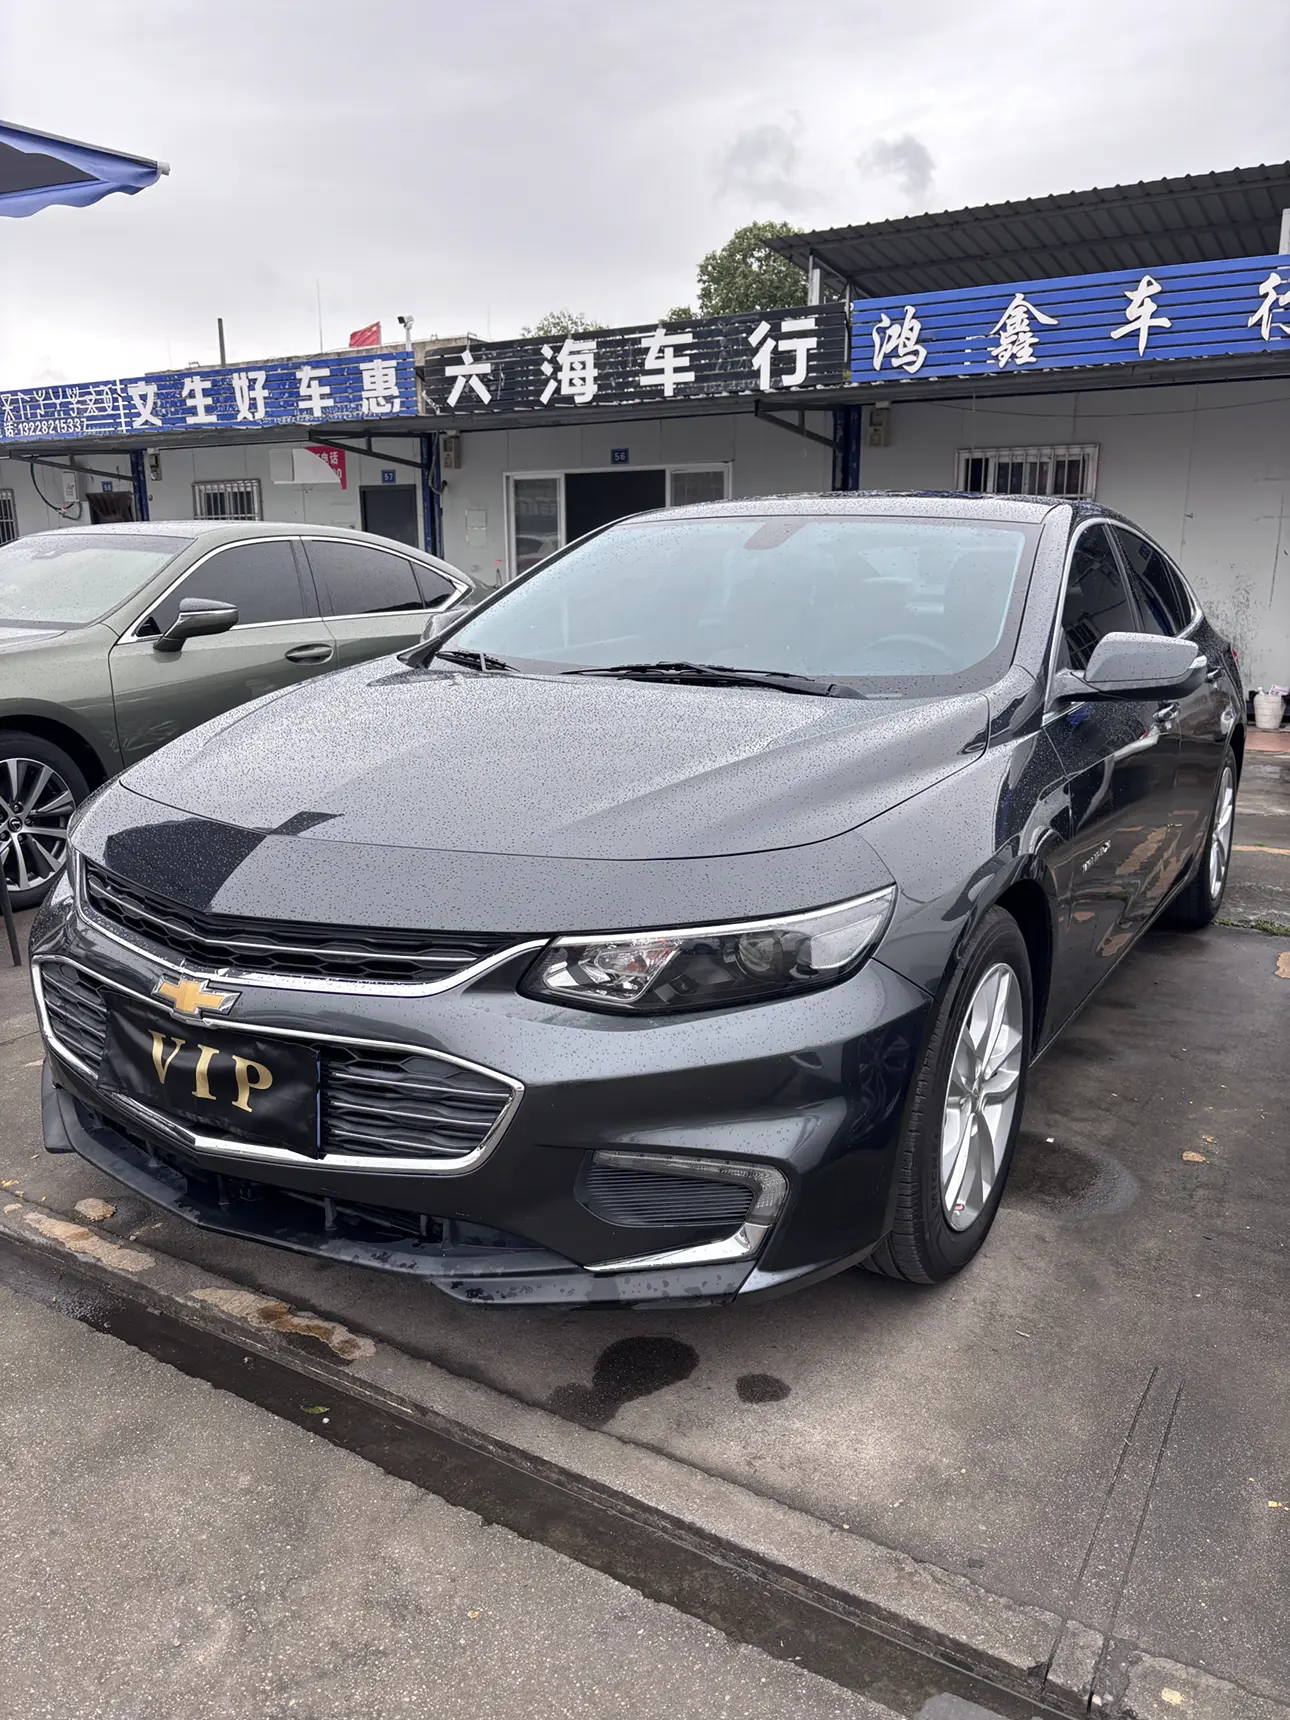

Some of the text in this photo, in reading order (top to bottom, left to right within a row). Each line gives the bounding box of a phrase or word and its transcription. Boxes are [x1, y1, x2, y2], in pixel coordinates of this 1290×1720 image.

[445, 318, 817, 408] 六海车行
[128, 359, 400, 427] 文生好车惠
[0, 418, 86, 438] 话:13228215337
[384, 472, 393, 481] 57
[614, 451, 626, 461] 56
[148, 1029, 273, 1112] VIP
